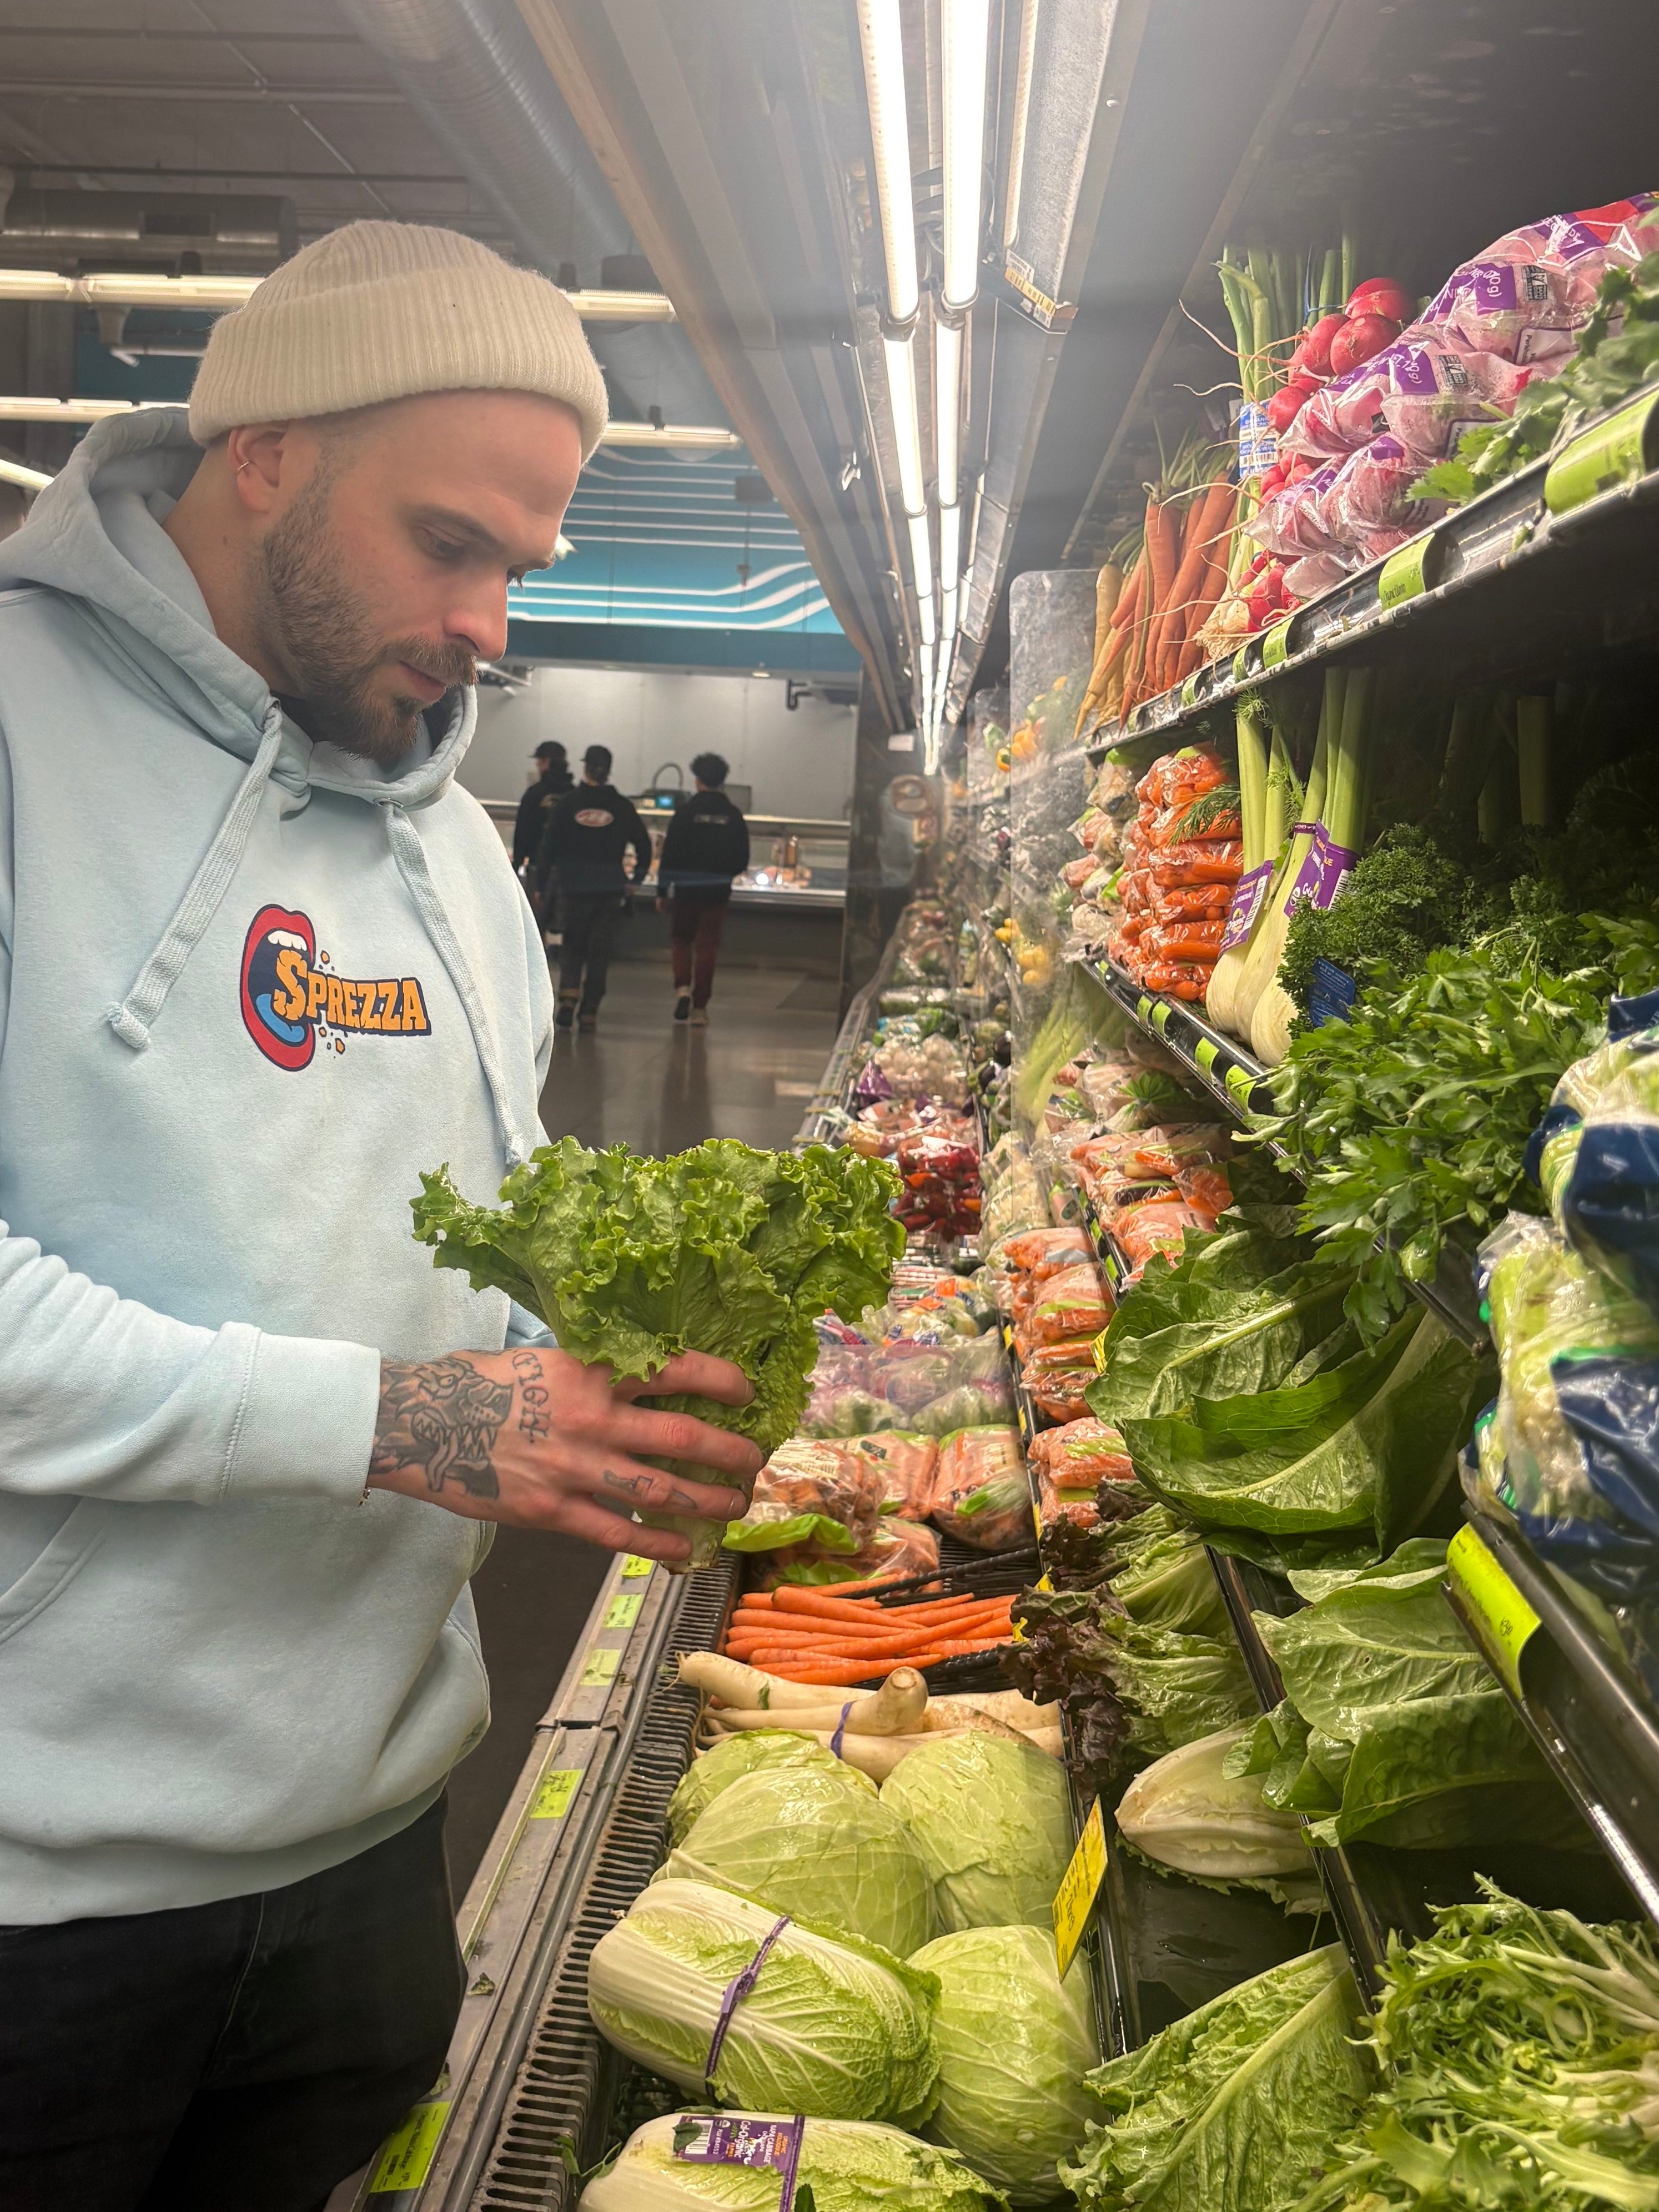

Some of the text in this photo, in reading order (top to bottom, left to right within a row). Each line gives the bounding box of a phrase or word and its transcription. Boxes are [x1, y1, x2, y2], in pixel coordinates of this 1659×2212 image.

[273, 949, 430, 1033] SPREZZA
[734, 2120, 751, 2158] Cal-Organic
[763, 2137, 775, 2163] CABBAGE
